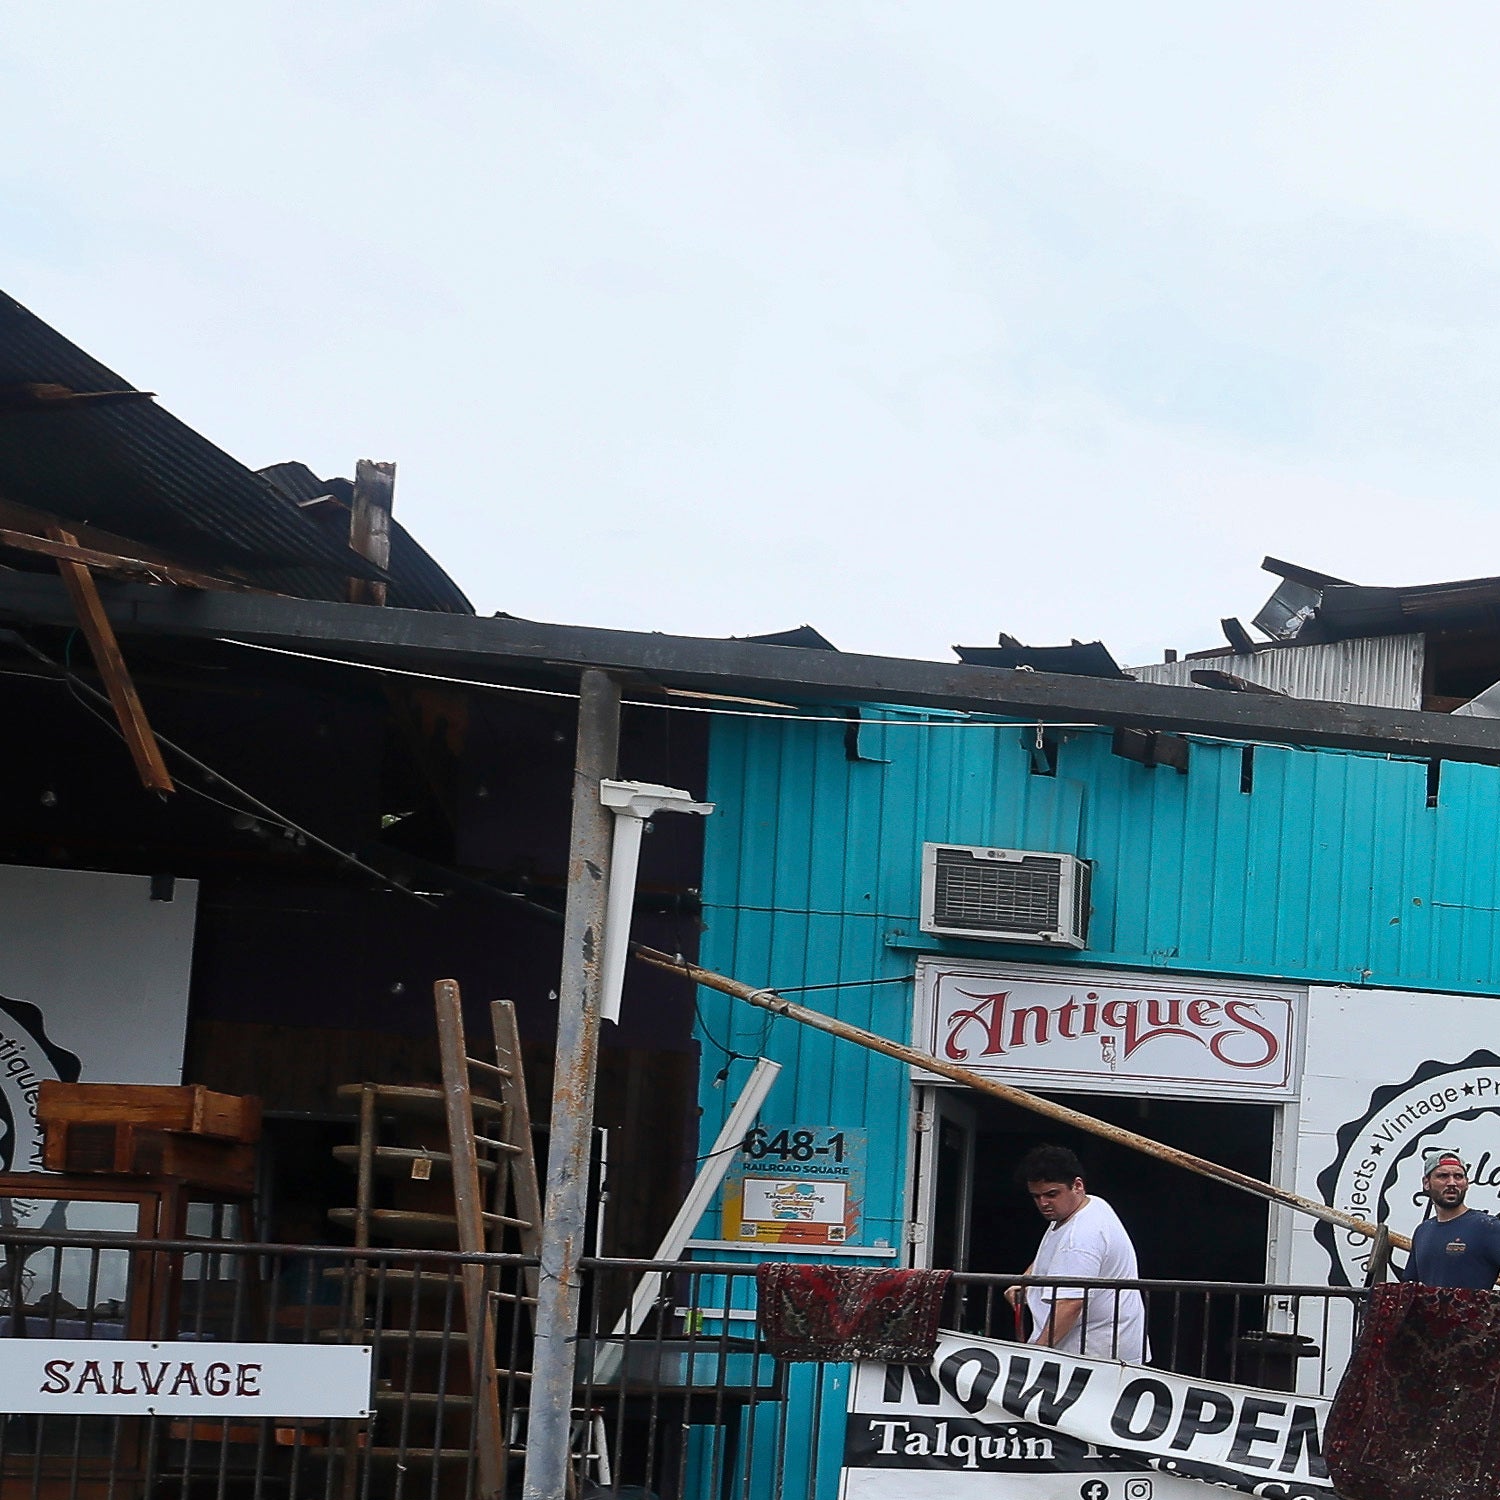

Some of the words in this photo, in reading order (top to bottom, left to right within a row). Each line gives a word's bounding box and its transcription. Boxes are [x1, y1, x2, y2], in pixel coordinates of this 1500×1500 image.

[944, 986, 1281, 1069] Antiques
[1372, 1086, 1459, 1143] Vintage
[742, 1162, 800, 1173] RAILROAD
[802, 1165, 849, 1175] SQUARE
[743, 1128, 845, 1163] 648-1
[40, 1360, 262, 1397] SALVAGE
[883, 1347, 1093, 1427] NOW
[1110, 1377, 1334, 1488] OPEN
[869, 1419, 1055, 1469] Talquin
